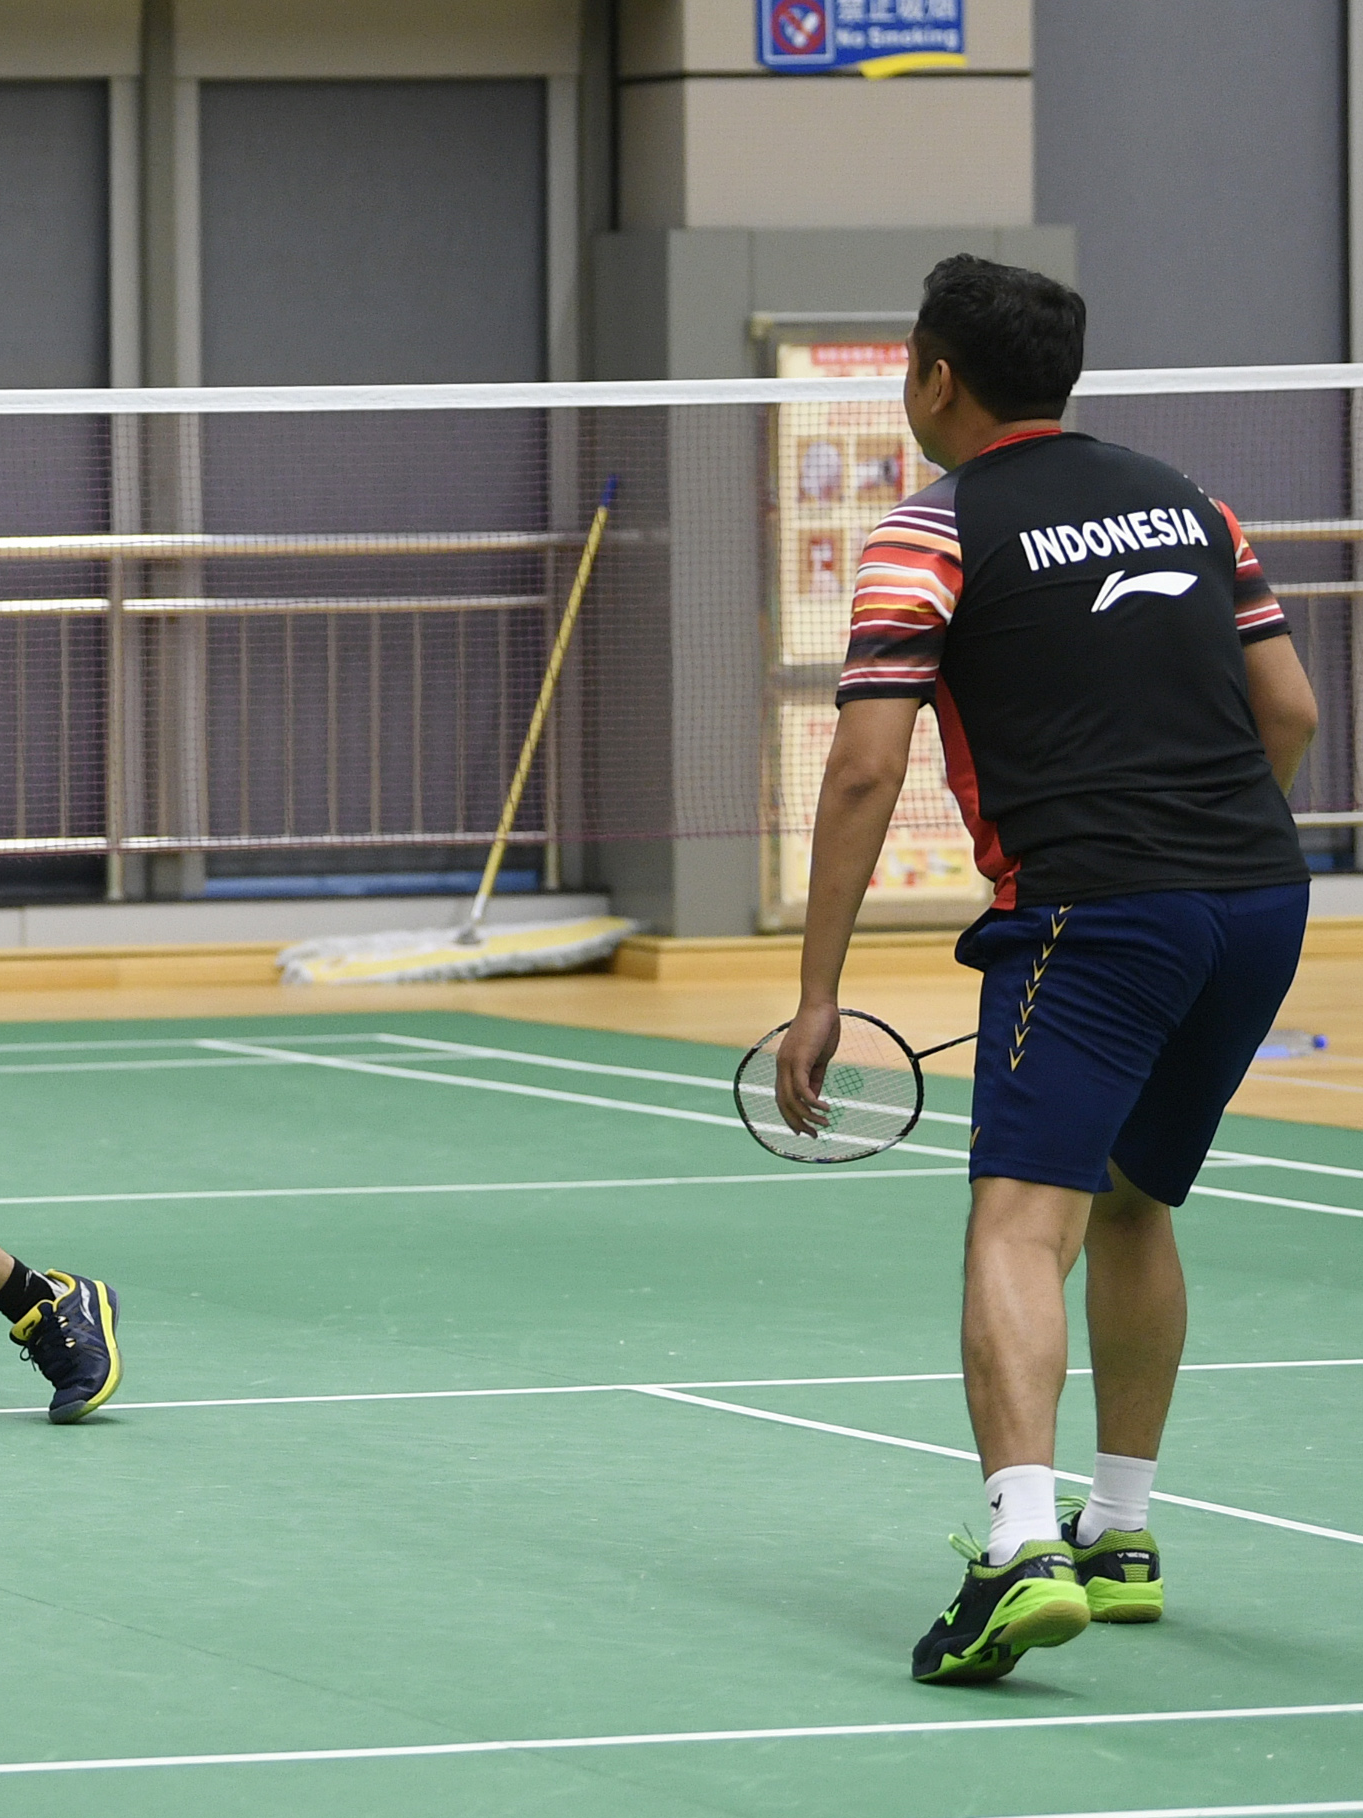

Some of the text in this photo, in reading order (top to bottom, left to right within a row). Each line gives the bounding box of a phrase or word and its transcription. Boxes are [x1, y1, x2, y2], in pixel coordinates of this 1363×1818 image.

[836, 26, 958, 51] No Smoking
[1019, 508, 1208, 571] INDONESIA
